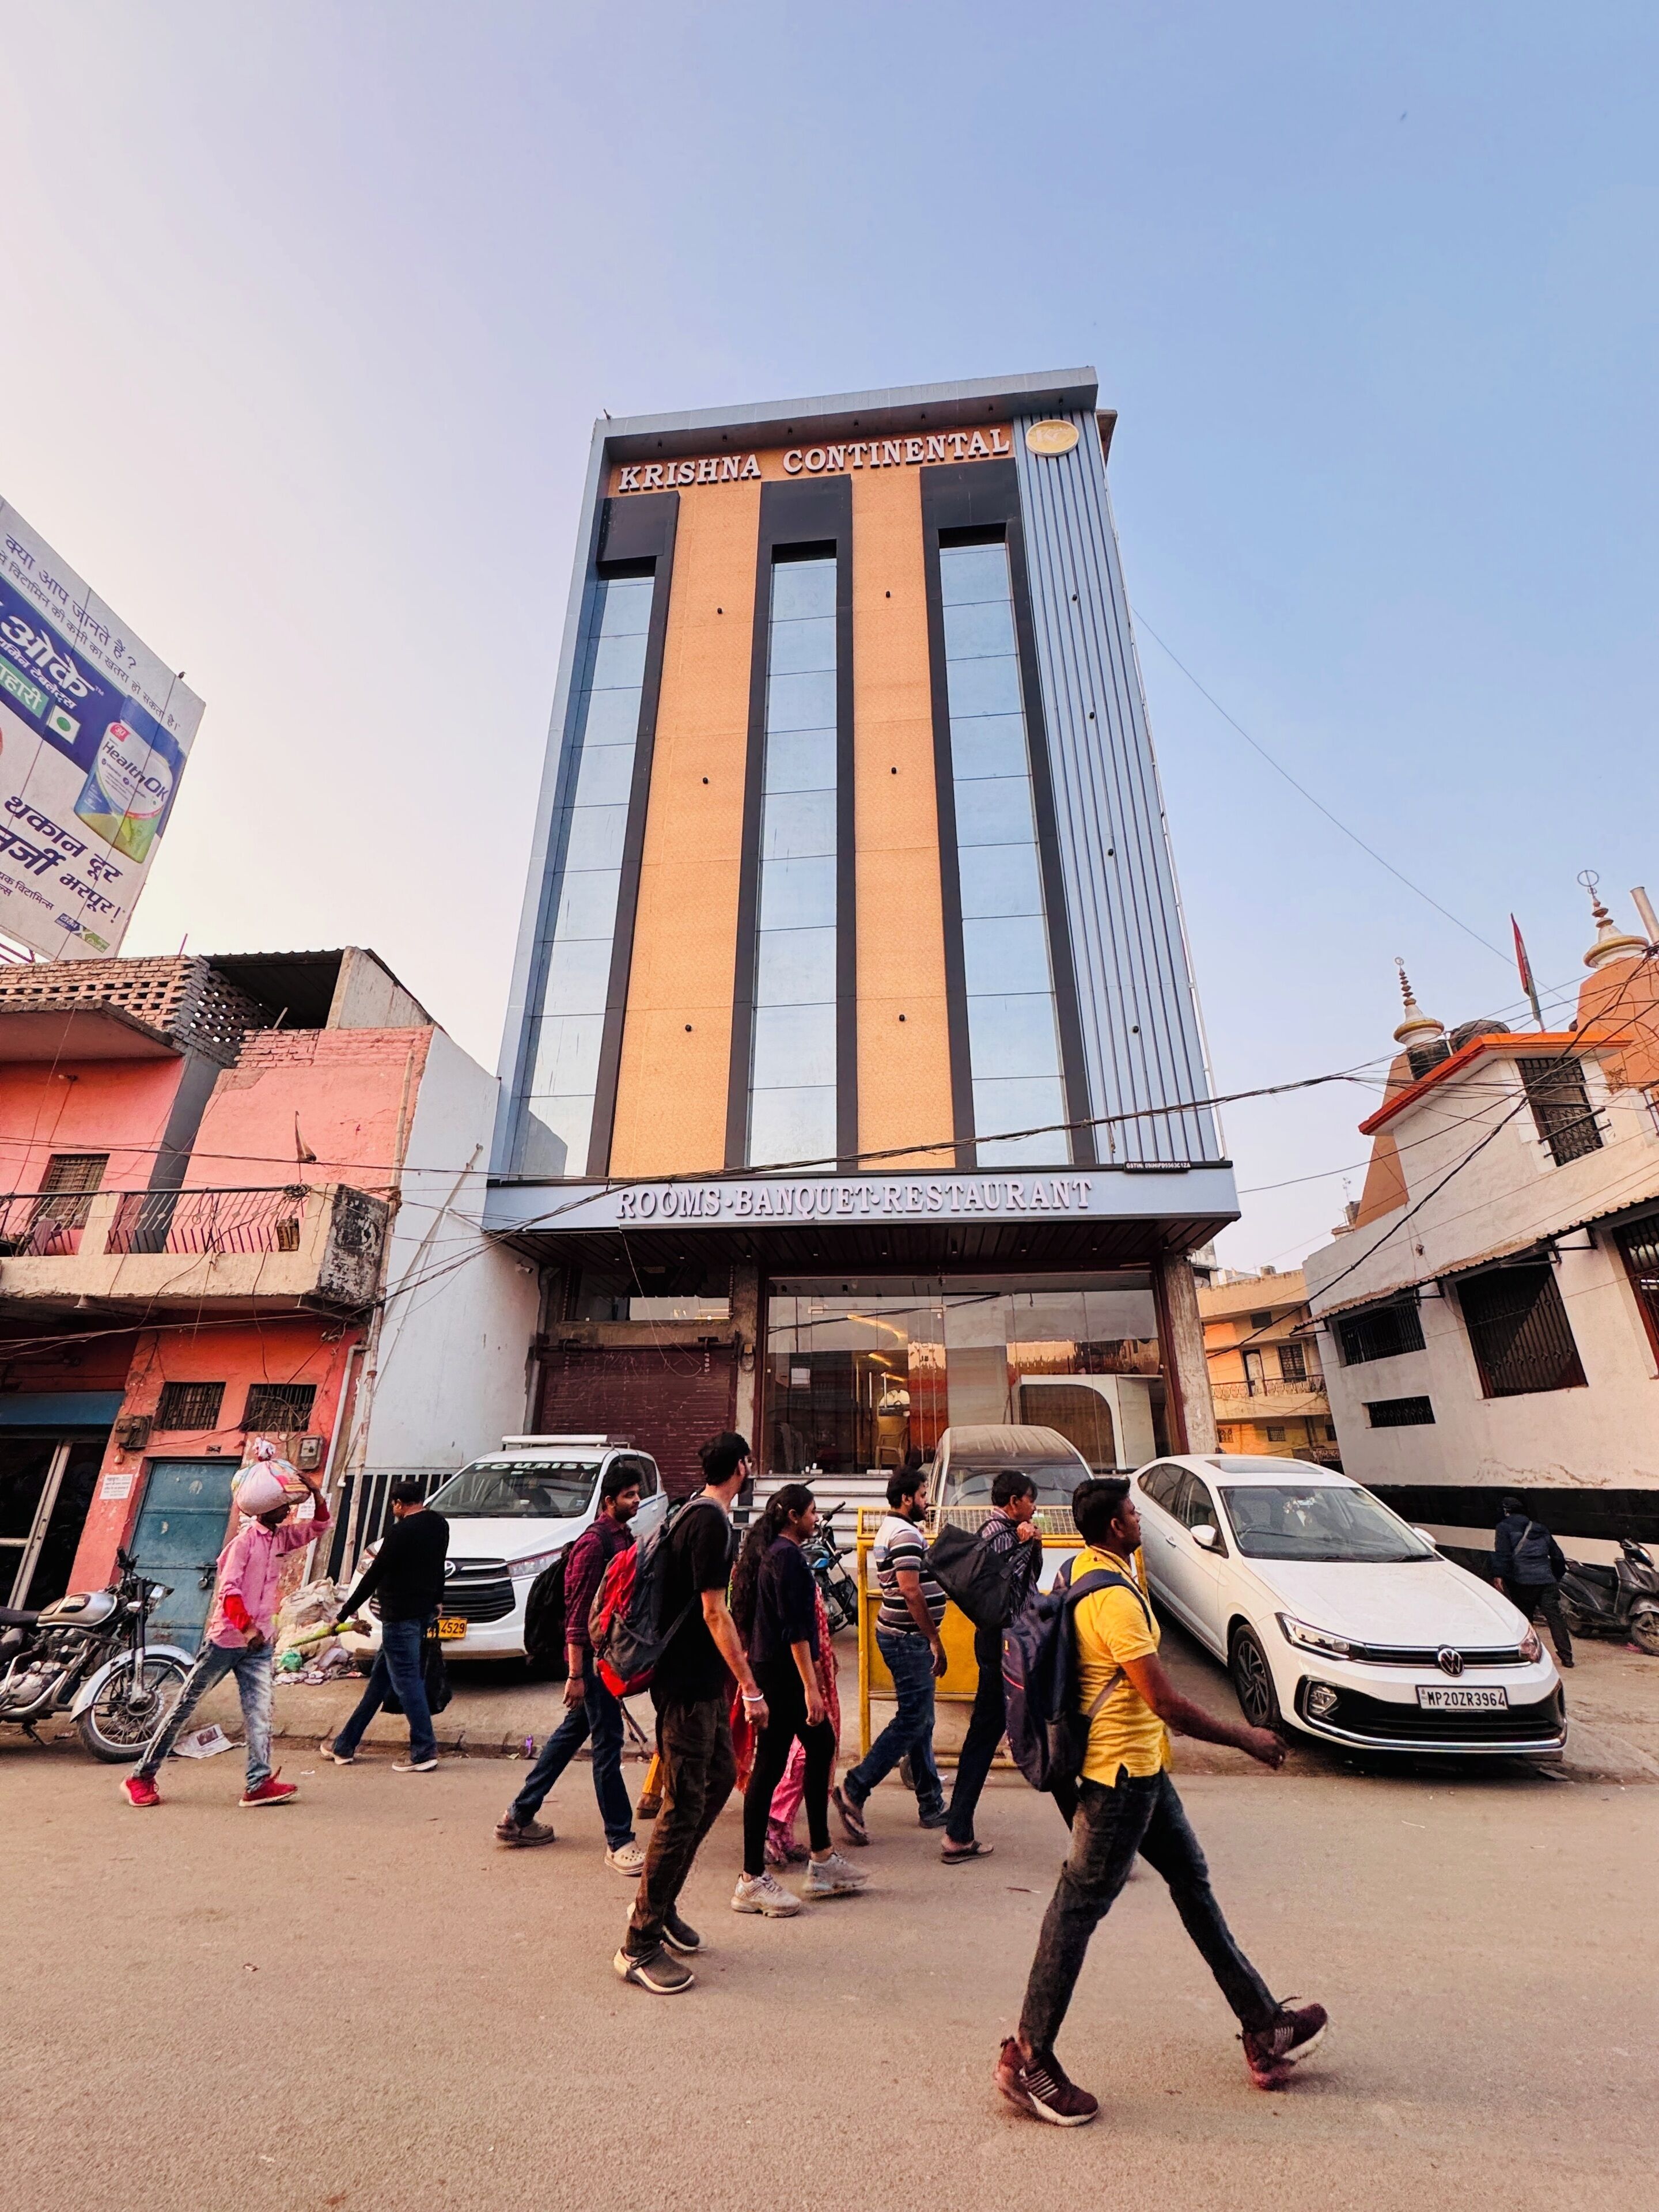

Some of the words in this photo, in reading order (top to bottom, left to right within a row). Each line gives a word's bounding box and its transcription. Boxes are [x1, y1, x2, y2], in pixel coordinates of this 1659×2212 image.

[619, 453, 762, 492] KRISHNA
[783, 428, 1011, 476] CONTINENTAL
[6, 533, 36, 570] क्या
[39, 569, 70, 605] आप
[73, 600, 111, 646] जानते
[1, 615, 95, 698] ओके
[9, 560, 50, 608] विटामिन
[51, 603, 66, 623] की
[66, 619, 88, 646] कमी
[89, 642, 103, 660] का
[105, 655, 130, 683] खतरा
[131, 678, 141, 695] हो
[5, 796, 89, 858] थकान
[87, 853, 124, 884] दूर
[15, 880, 55, 911] विटामिन्स
[474, 1463, 599, 1471] TOURIST
[1427, 1691, 1506, 1707] MP20ZR3964
